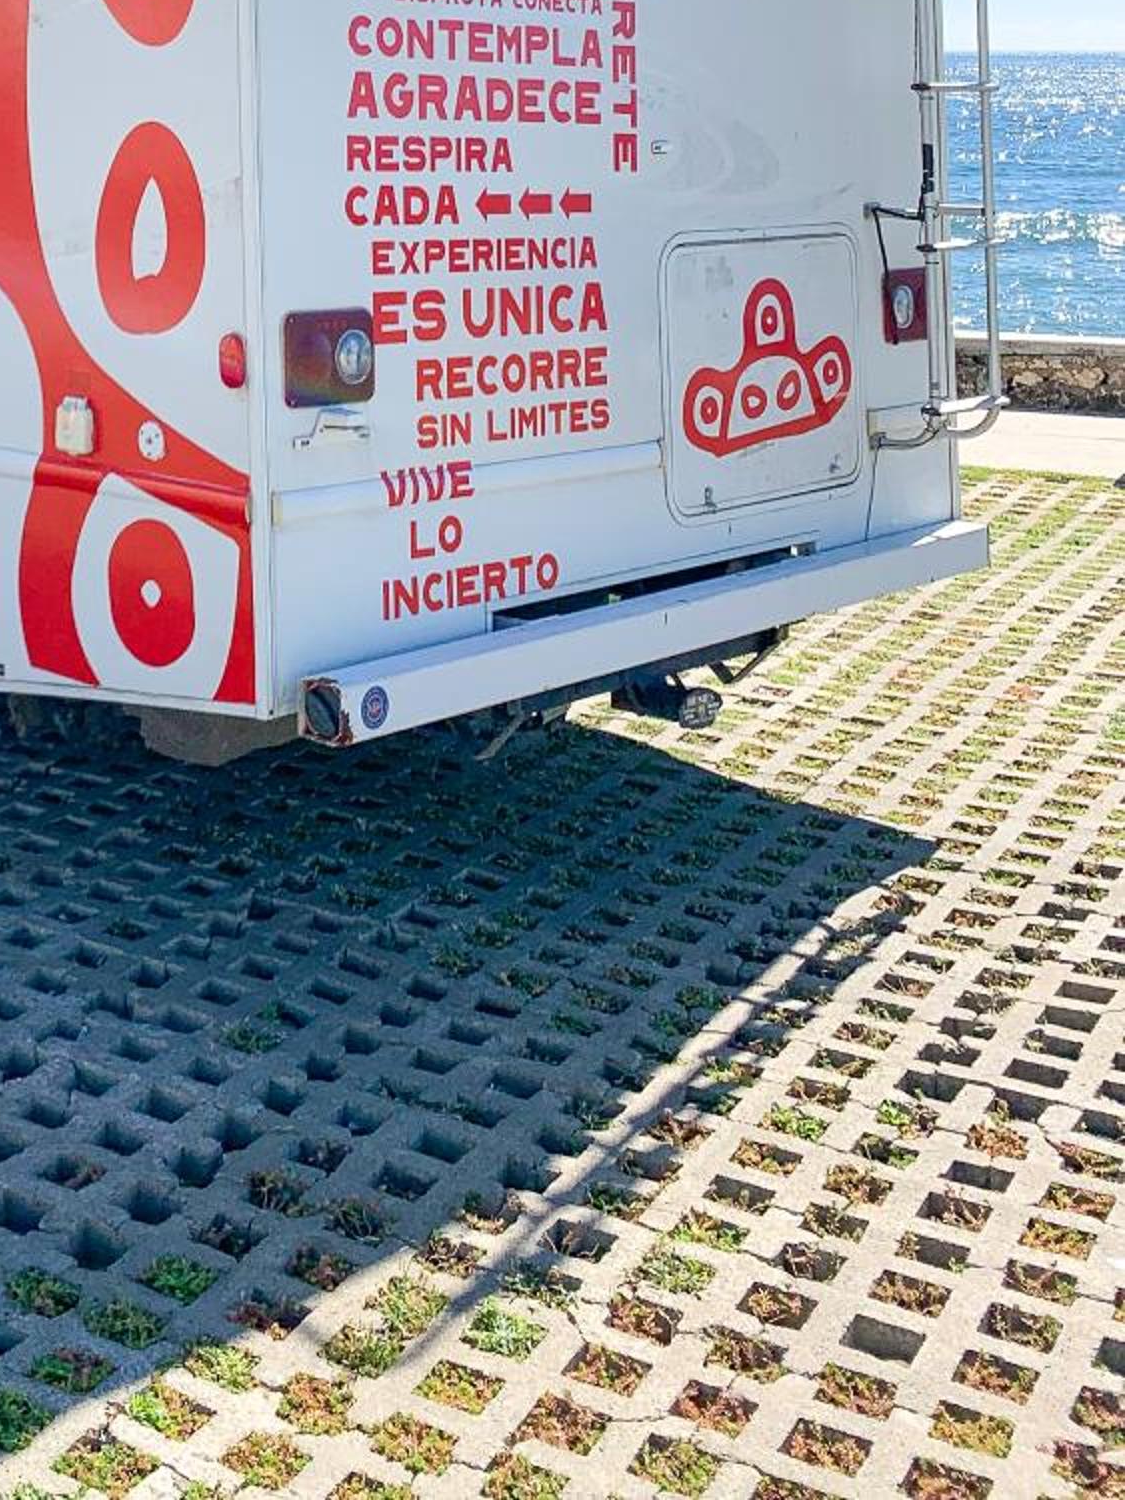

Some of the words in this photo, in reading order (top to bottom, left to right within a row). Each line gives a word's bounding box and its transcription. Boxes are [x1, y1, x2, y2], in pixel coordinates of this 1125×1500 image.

[347, 15, 604, 69] CONTEMPLA
[347, 71, 602, 125] AGRADECE
[346, 135, 514, 173] RESPIRA
[344, 184, 460, 226] CADA
[371, 236, 598, 276] EXPERIENCIA
[370, 288, 448, 346] ES
[462, 282, 608, 340] UNICA
[415, 346, 608, 402] RECORRE
[416, 411, 473, 449] SIN
[486, 398, 611, 442] LIMITES
[381, 459, 475, 508] VIVE
[409, 514, 463, 560] LO
[381, 552, 560, 621] INCIERTO
